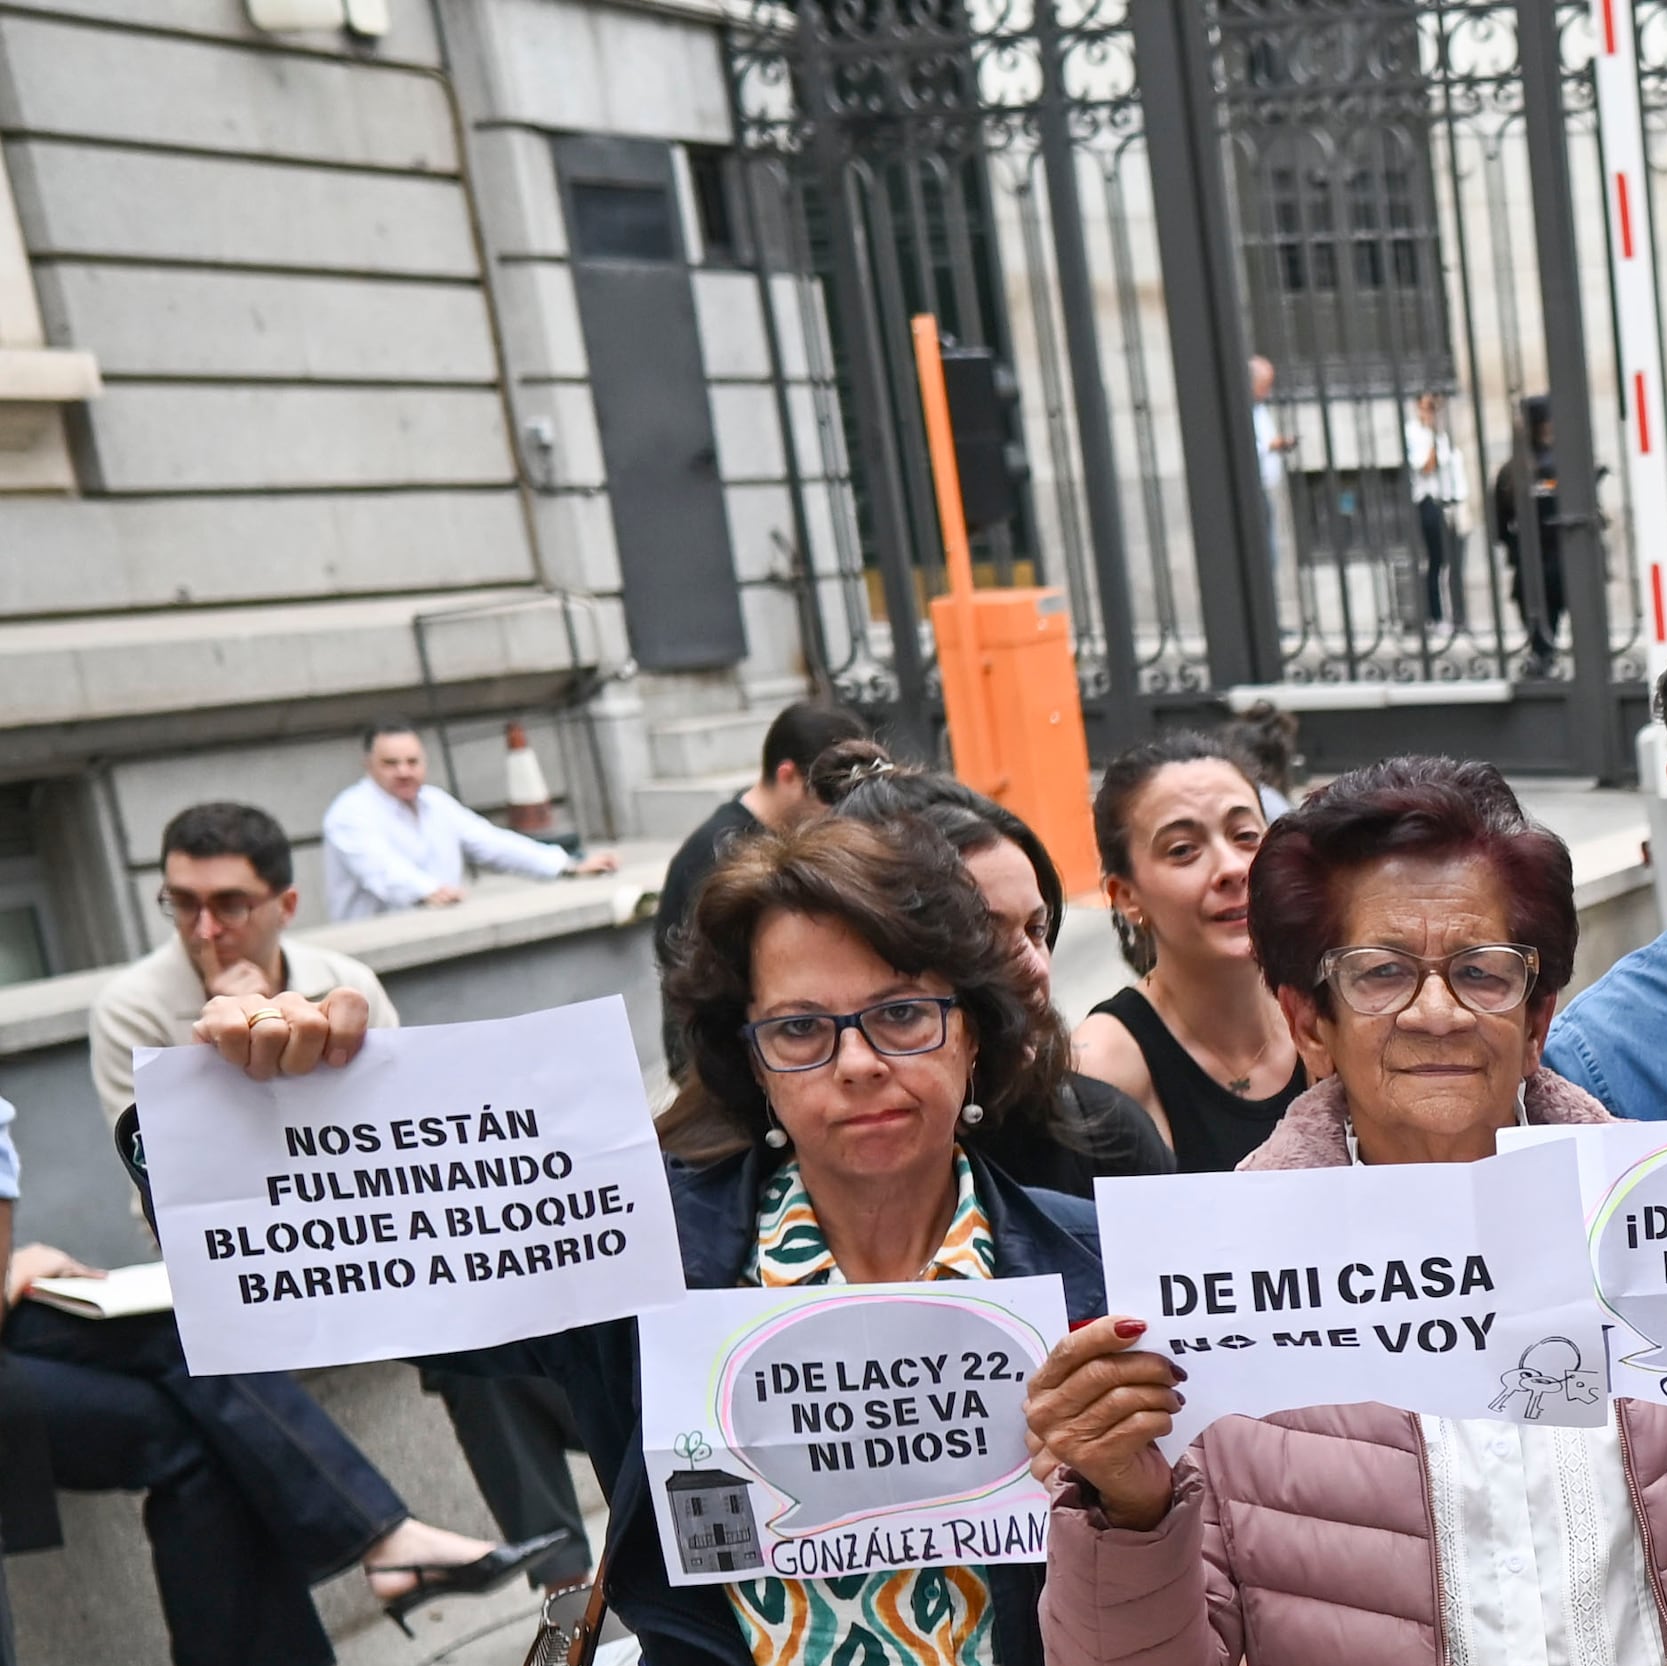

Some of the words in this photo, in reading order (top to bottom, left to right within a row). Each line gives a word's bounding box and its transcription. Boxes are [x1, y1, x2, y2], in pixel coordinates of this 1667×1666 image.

[285, 1124, 381, 1156] NOS
[390, 1104, 539, 1150] ESTÁN
[267, 1151, 573, 1206] FULMINANDO
[205, 1213, 397, 1260] BLOQUE
[410, 1211, 437, 1240] A
[445, 1185, 634, 1237] BLOQUE,
[238, 1258, 415, 1304] BARRIO
[429, 1255, 456, 1285] A
[464, 1229, 626, 1281] BARRIO
[1160, 1272, 1236, 1316] DE
[1251, 1267, 1321, 1312] MI
[1338, 1255, 1494, 1304] CASA
[1169, 1335, 1256, 1355] NO
[1272, 1328, 1360, 1347] ME
[1373, 1312, 1496, 1353] VOY
[755, 1362, 826, 1402] ¡DE
[836, 1354, 947, 1391] LACY
[961, 1352, 1024, 1382] 22,
[792, 1402, 853, 1433] NO
[865, 1397, 919, 1429] SE
[927, 1390, 989, 1421] VA
[808, 1442, 854, 1472] NI
[865, 1427, 987, 1468] DIOS!
[771, 1527, 942, 1575] GONZÁLEZ
[942, 1511, 1047, 1558] RUAN
